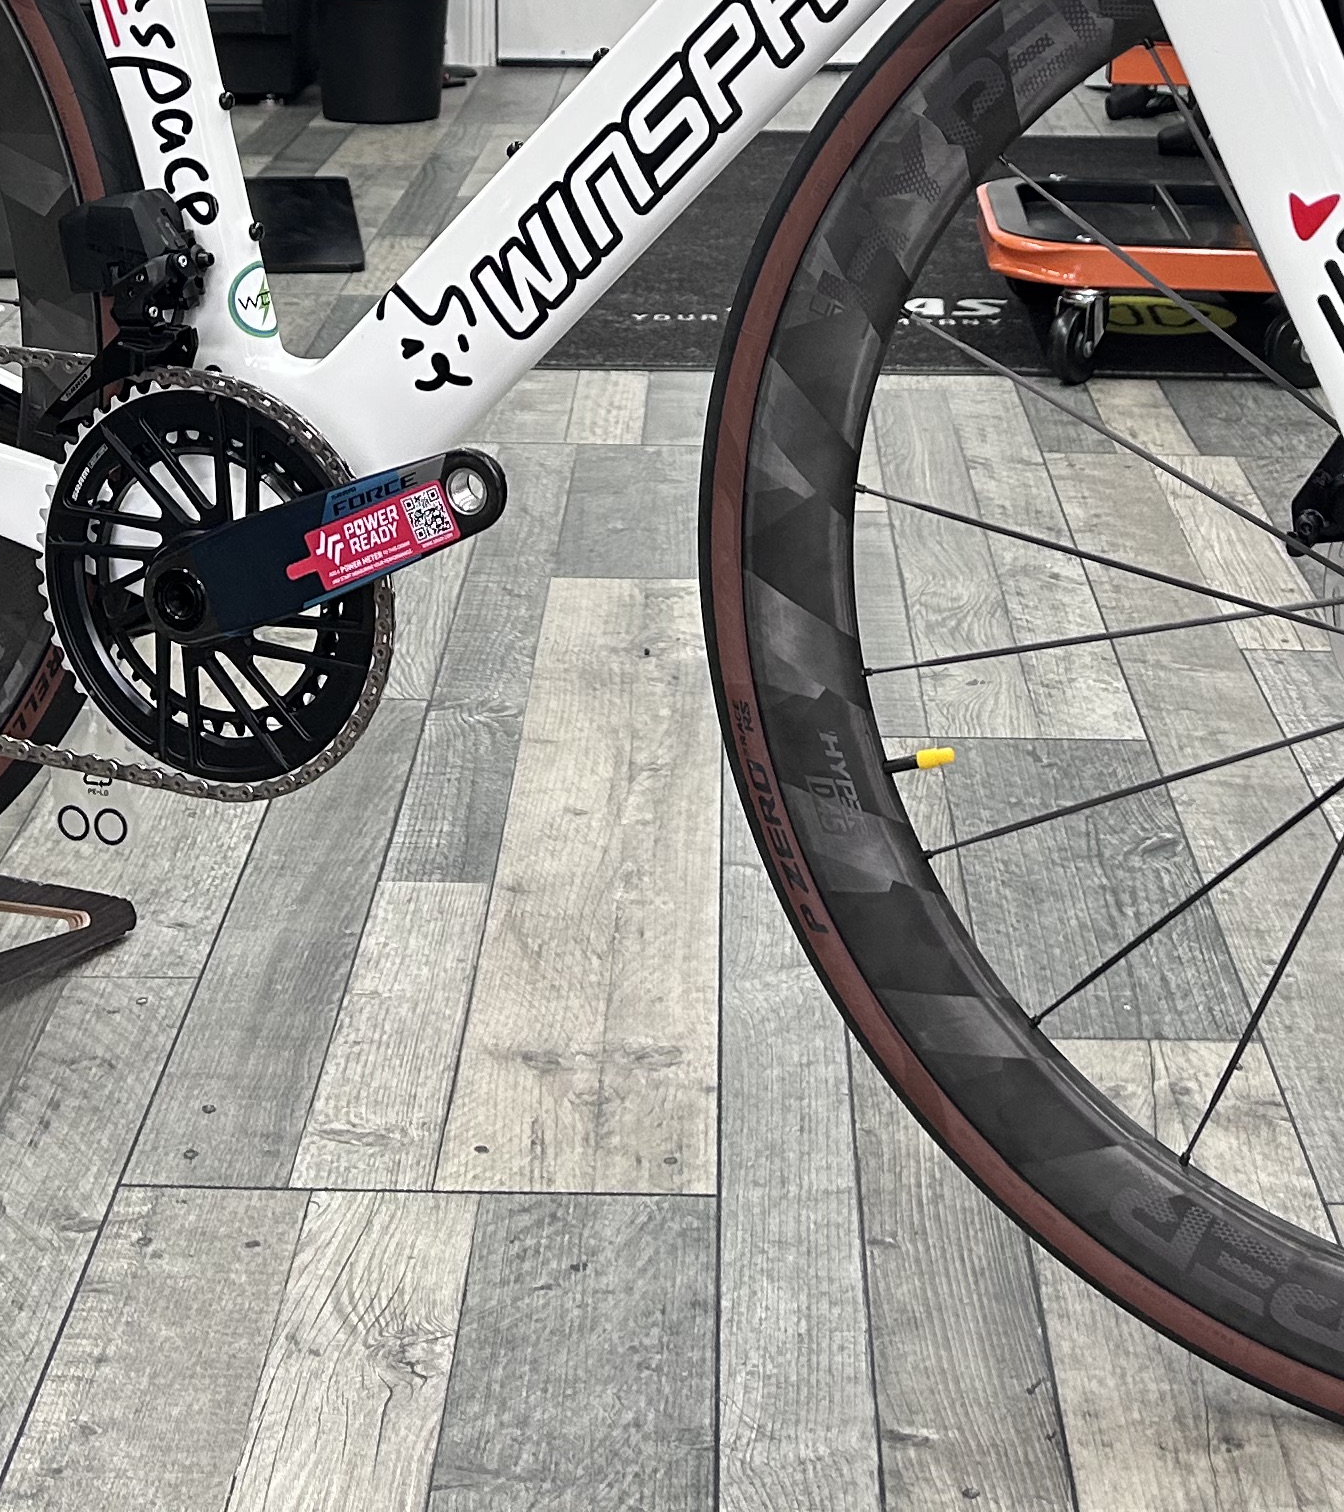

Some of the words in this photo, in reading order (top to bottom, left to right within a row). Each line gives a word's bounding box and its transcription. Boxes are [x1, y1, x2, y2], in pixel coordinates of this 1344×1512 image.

[332, 471, 418, 517] FORCE
[343, 504, 400, 540] POWER
[349, 521, 399, 555] READY
[747, 758, 810, 894] ZERO
